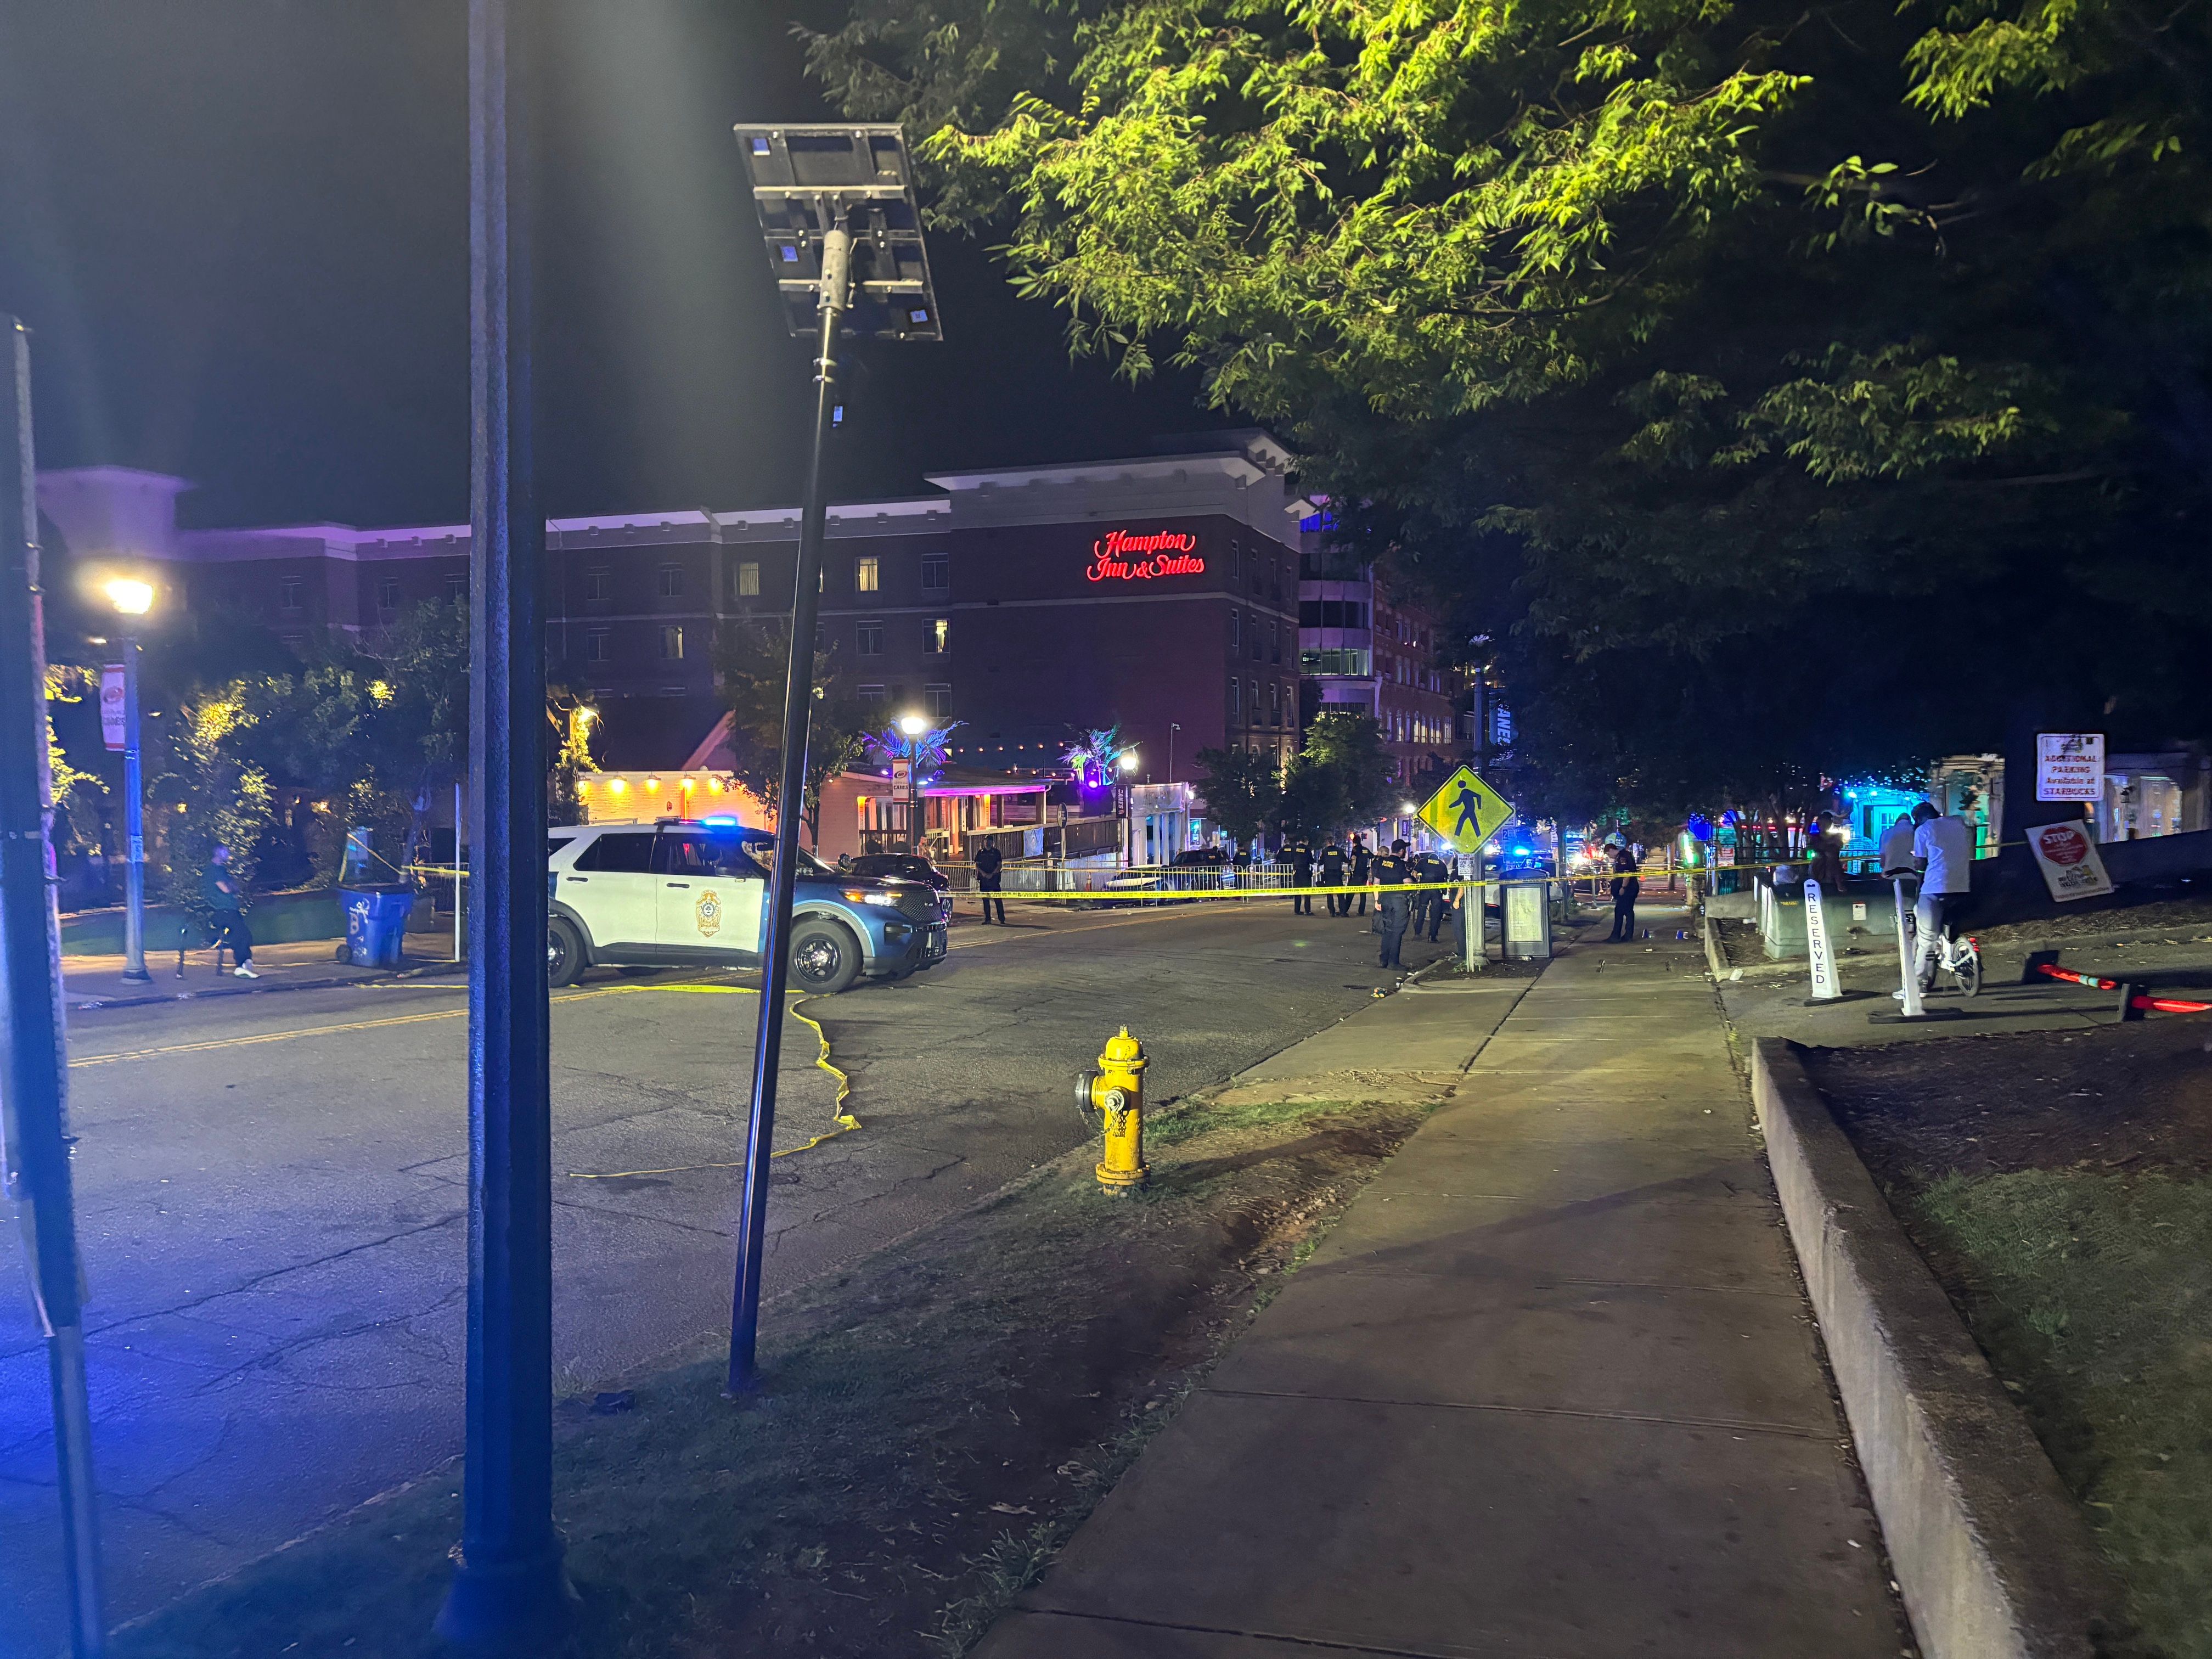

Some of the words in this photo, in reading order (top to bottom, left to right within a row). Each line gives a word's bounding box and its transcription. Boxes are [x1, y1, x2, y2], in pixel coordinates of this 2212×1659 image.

[1094, 530, 1196, 559] Hampton
[1087, 557, 1136, 581] Inn
[1136, 561, 1151, 579] &
[1149, 554, 1205, 576] Suites
[2042, 830, 2074, 844] STOP
[1807, 893, 1825, 984] RESERVED
